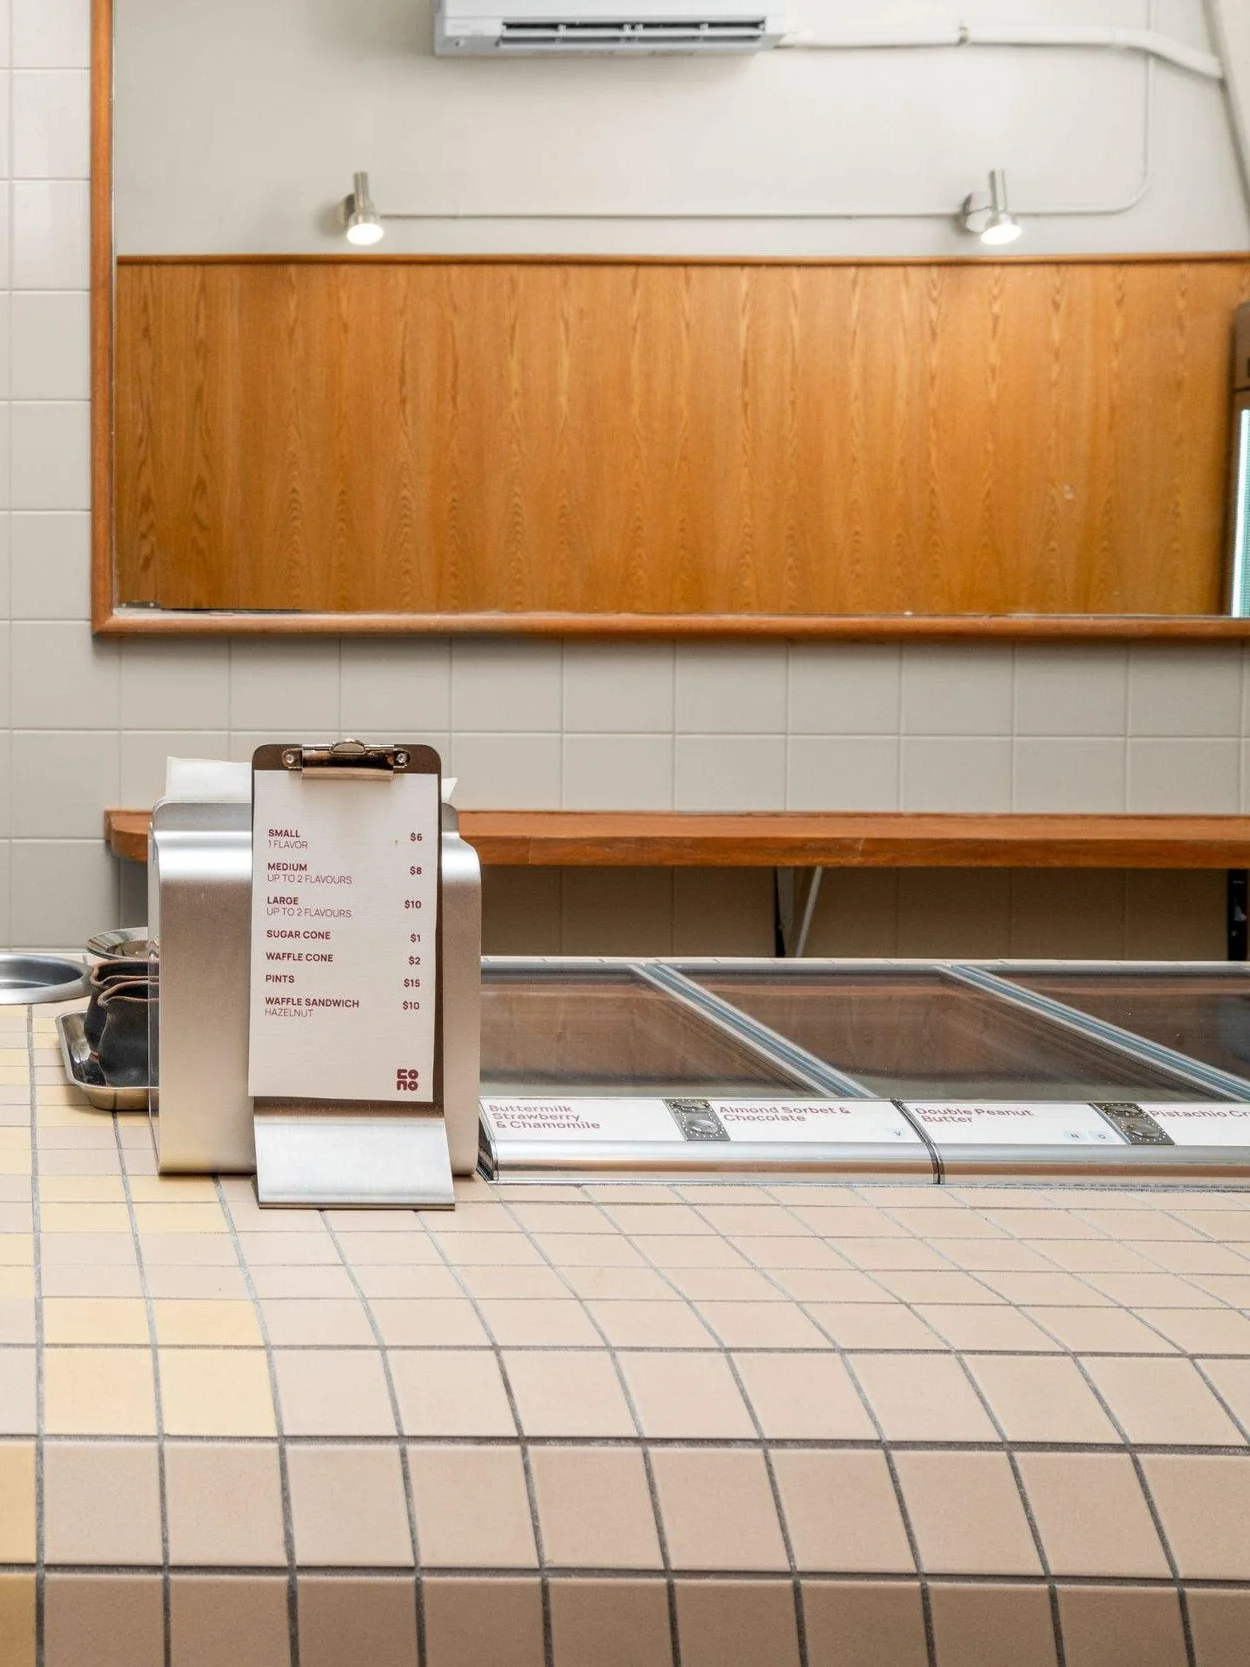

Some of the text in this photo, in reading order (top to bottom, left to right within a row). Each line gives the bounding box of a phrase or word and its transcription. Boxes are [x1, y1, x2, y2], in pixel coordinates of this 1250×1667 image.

[268, 828, 301, 838] SMALL
[410, 833, 423, 842] $6
[268, 840, 308, 849] 1 FLAVOR
[267, 862, 308, 872] MEDIUM
[409, 866, 423, 876] $8
[267, 874, 353, 885] UP TO 2 FLAVOURS
[267, 896, 299, 905] LARGE
[404, 899, 422, 909] $10
[266, 907, 352, 919] UP TO 2 FLAVOURS
[266, 930, 331, 940] SUGAR CONE
[410, 933, 421, 943] $1
[265, 952, 334, 963] WAFFLE CONE
[408, 956, 421, 966] $2
[265, 974, 295, 983] PINTS
[403, 978, 421, 988] $15
[265, 997, 360, 1008] WAFFLE SANDWICH
[402, 1001, 420, 1010] $10
[264, 1008, 314, 1018] HAZELNUT
[488, 1104, 573, 1113] Buttermilk
[719, 1106, 779, 1114] Almond
[781, 1106, 837, 1114] Sorbet
[914, 1107, 1033, 1117] Double Peanut
[492, 1112, 580, 1122] Strawberry
[723, 1114, 806, 1122] Chocolate
[921, 1115, 973, 1123] Butter
[1149, 1110, 1228, 1118] Pistachio
[496, 1120, 601, 1130] & Chamomile
